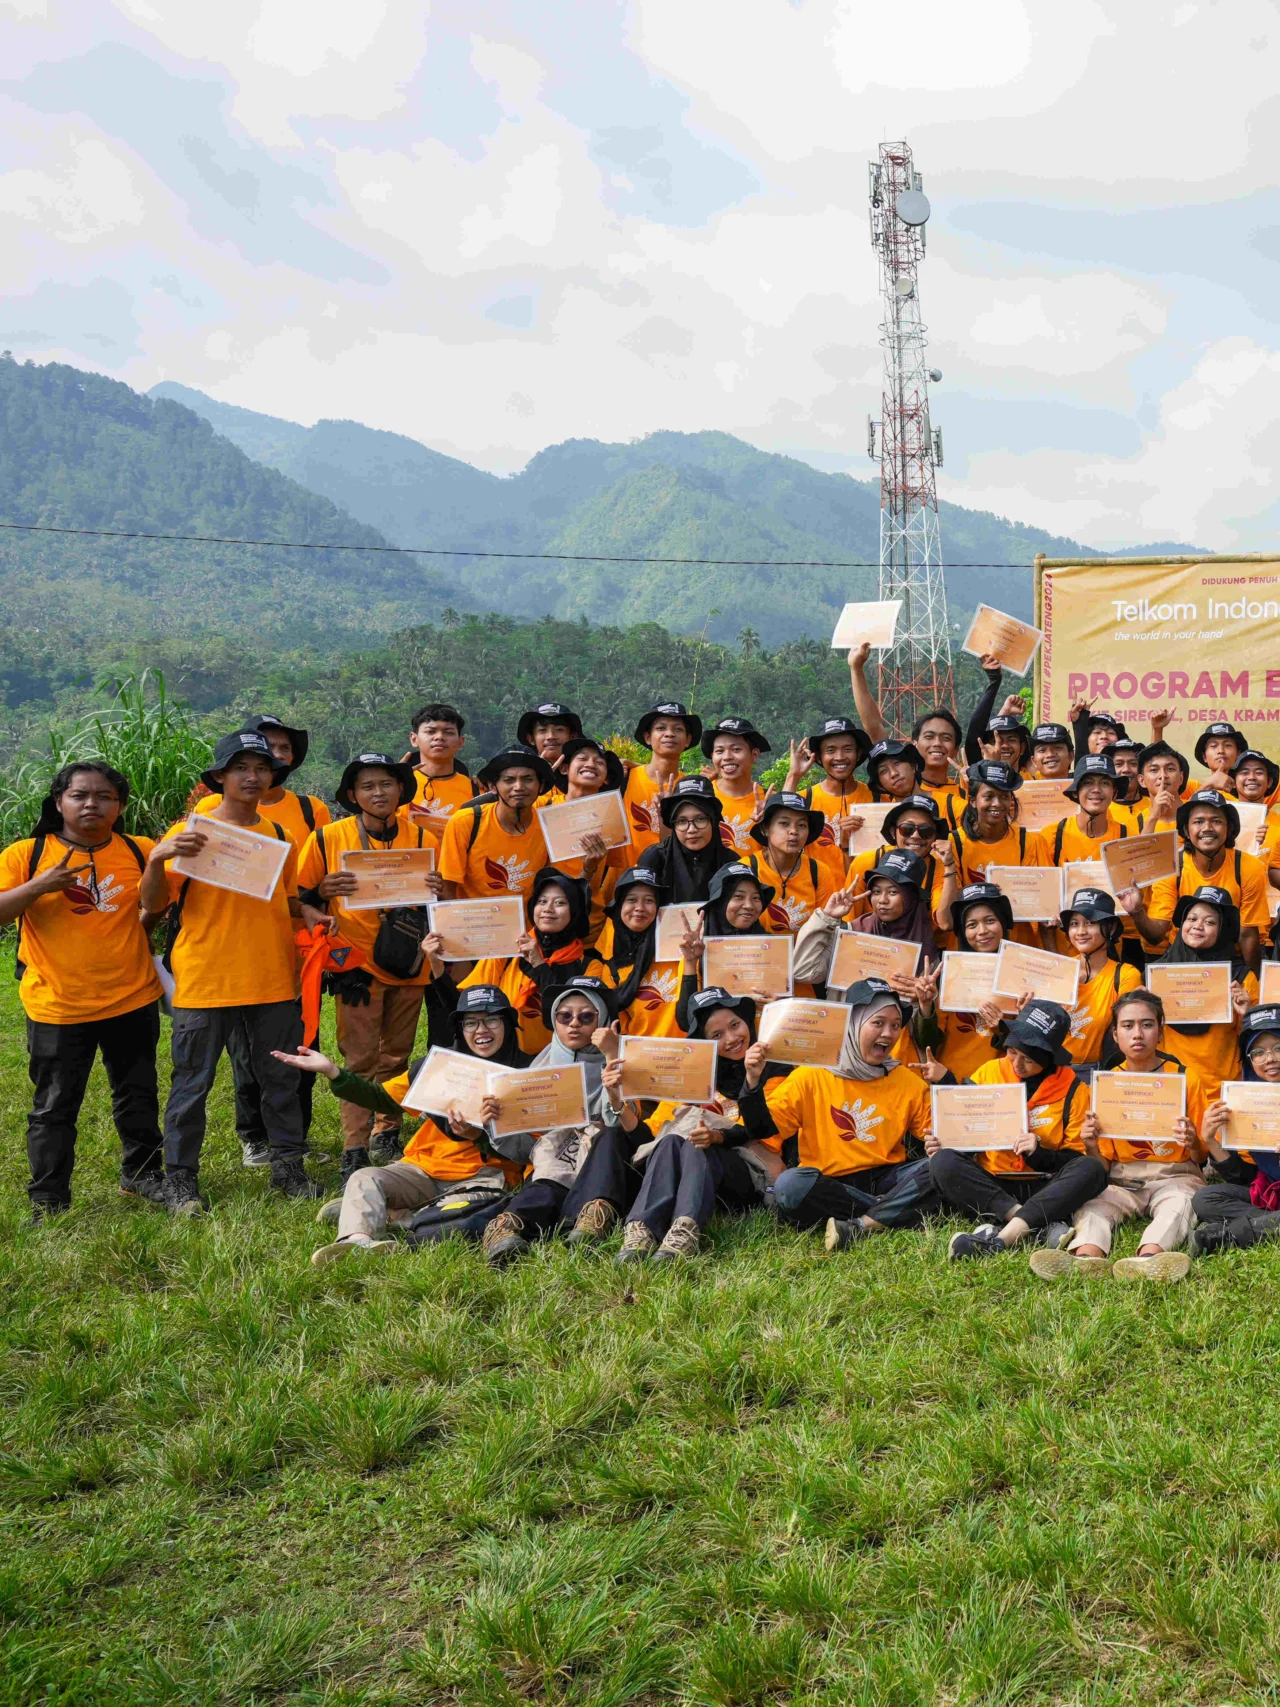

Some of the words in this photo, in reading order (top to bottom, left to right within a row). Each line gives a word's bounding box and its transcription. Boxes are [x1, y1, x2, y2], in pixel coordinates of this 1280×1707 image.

[1201, 577, 1246, 585] DIDUKUNG
[1248, 576, 1278, 584] PENUH
[1111, 598, 1197, 621] Telkom
[1114, 631, 1130, 641] the
[1132, 631, 1160, 640] world
[1162, 631, 1170, 640] in
[1174, 631, 1195, 641] your
[1198, 629, 1223, 639] hand
[1068, 670, 1249, 700] PROGRAM
[1114, 709, 1183, 723] SIREL,
[1187, 709, 1231, 722] DESA
[520, 1084, 553, 1092] SERTIFIKAT
